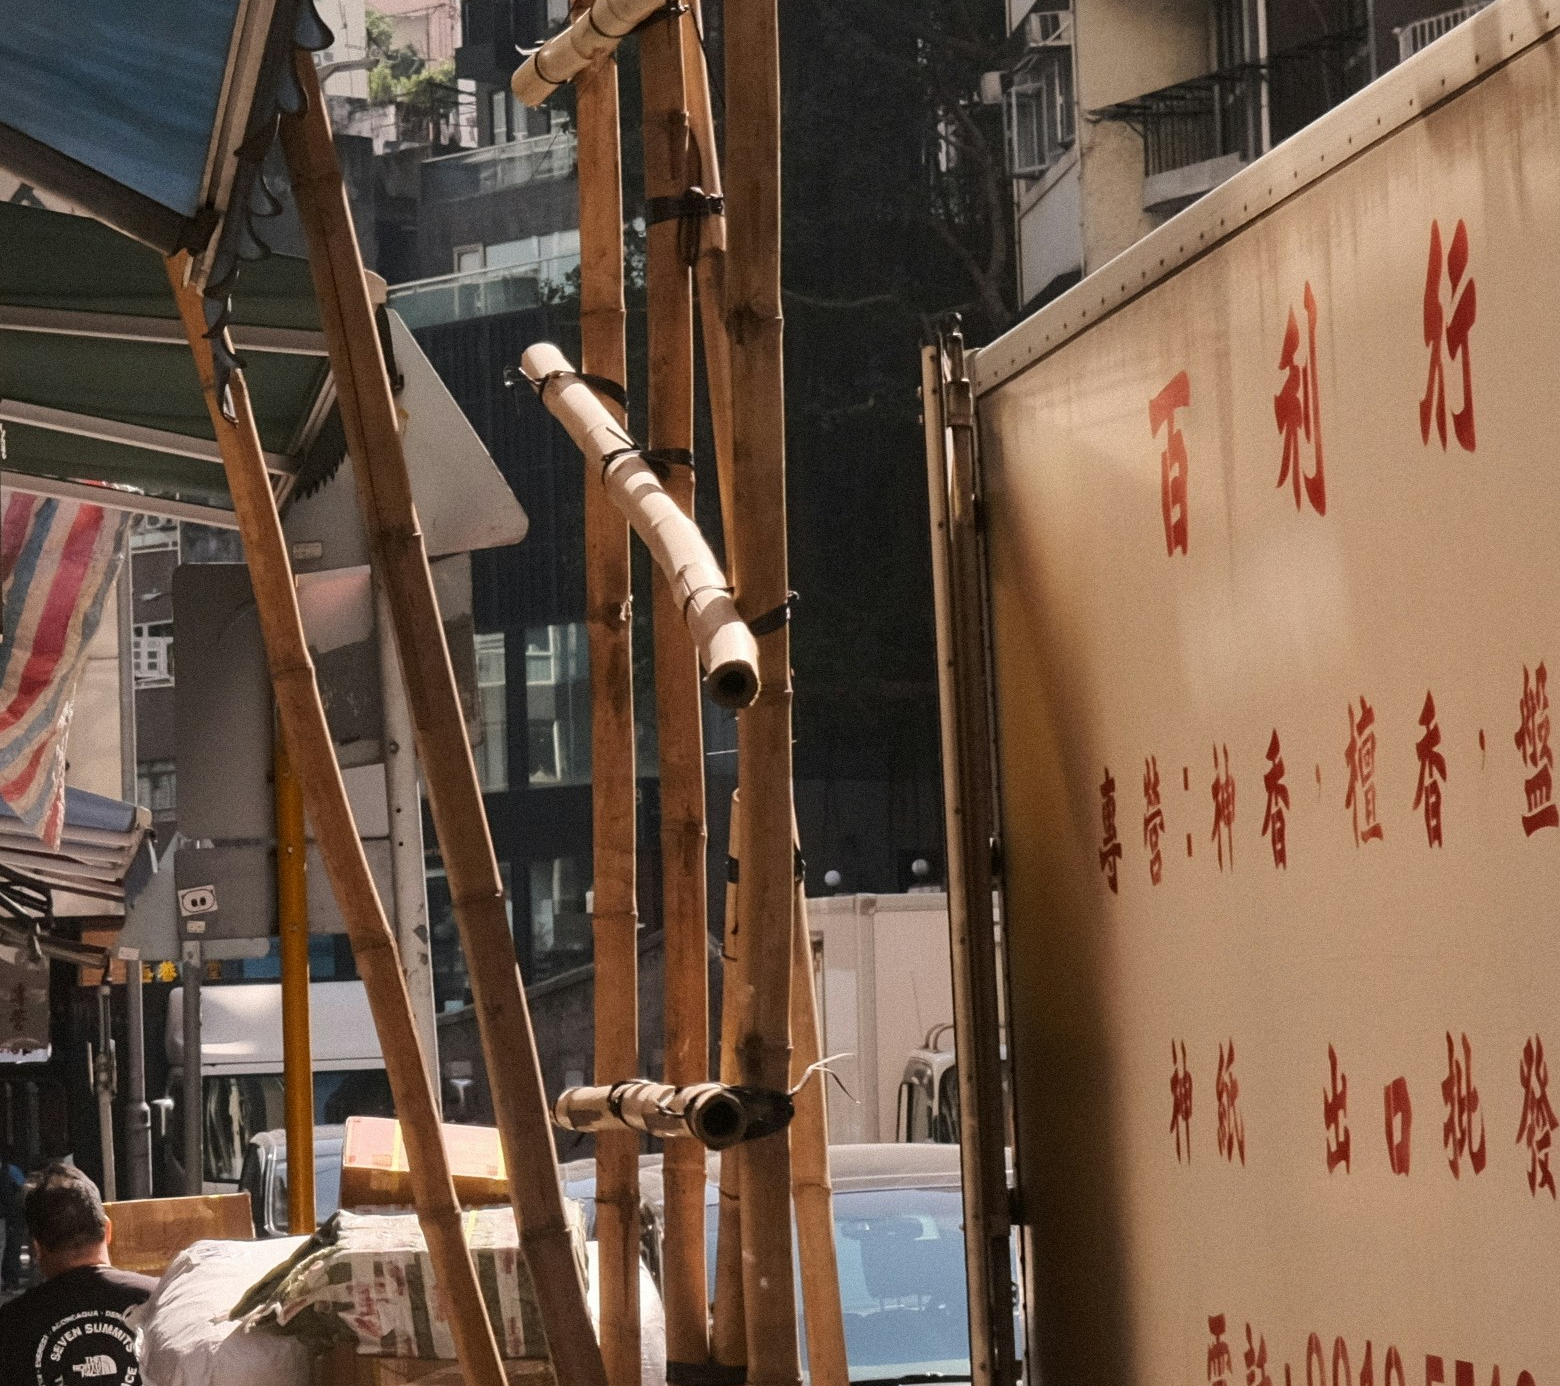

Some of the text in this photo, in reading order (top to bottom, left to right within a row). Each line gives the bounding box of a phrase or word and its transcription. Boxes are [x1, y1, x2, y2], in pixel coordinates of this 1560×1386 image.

[1149, 217, 1477, 557] 百利行
[1323, 1030, 1560, 1201] 出口批發
[50, 1322, 136, 1362] SEVEN SUMMITS
